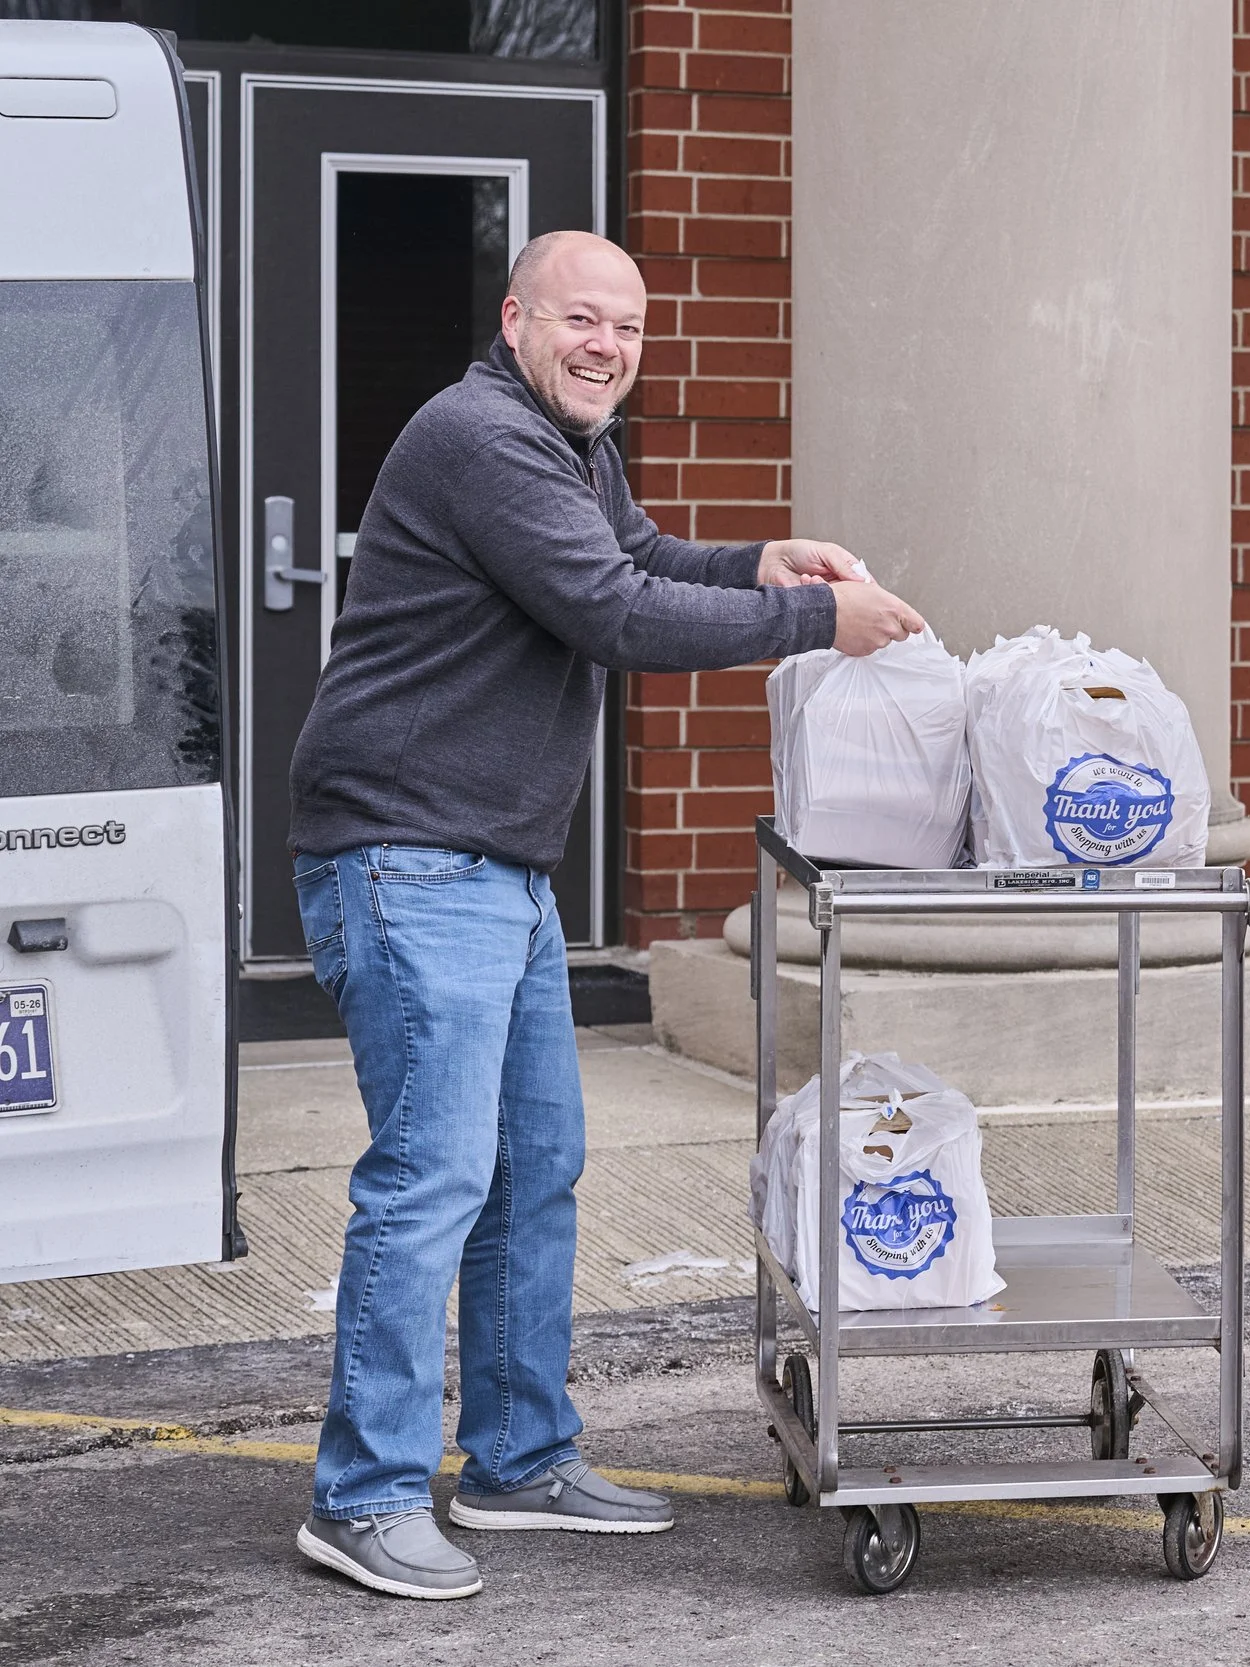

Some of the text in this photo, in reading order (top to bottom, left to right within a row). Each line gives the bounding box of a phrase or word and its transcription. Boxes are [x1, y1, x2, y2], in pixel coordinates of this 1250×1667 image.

[1054, 795, 1167, 829] Thank you
[1070, 826, 1147, 856] Shopping with us
[1102, 822, 1117, 834] for
[14, 1000, 41, 1010] 05-26
[908, 1199, 949, 1231] you
[866, 1227, 934, 1263] Shopping with us
[893, 1230, 903, 1242] for
